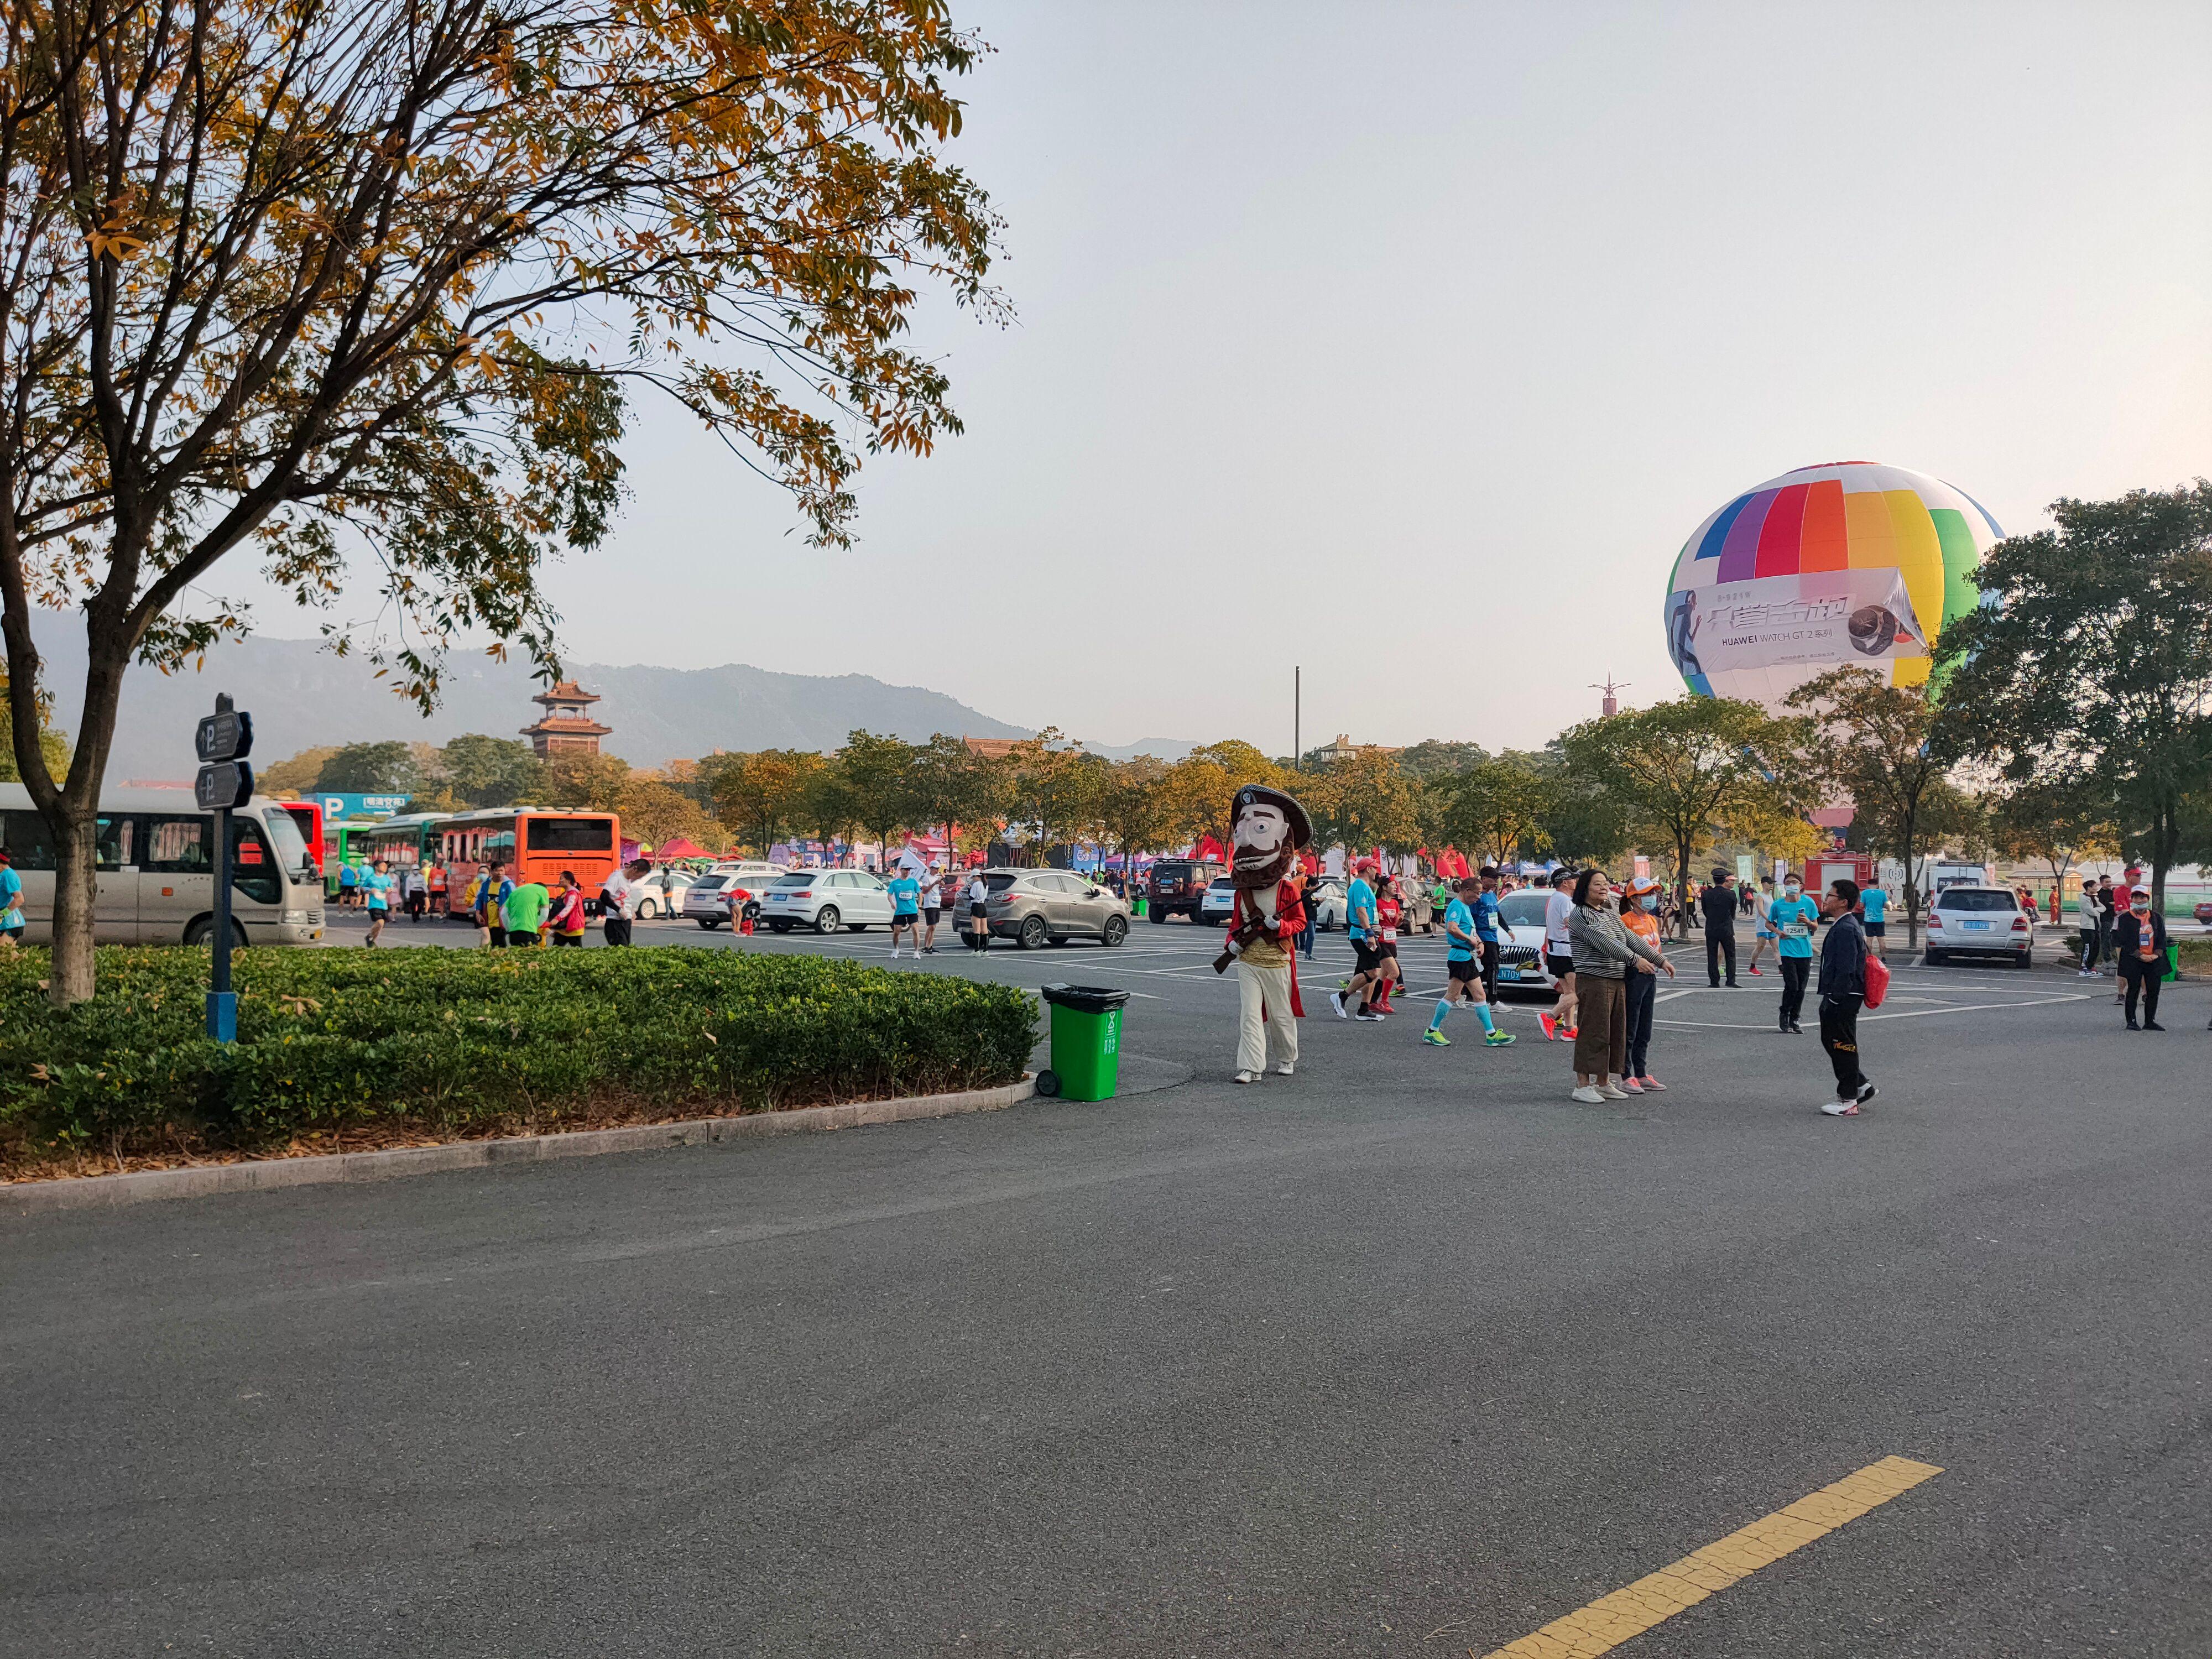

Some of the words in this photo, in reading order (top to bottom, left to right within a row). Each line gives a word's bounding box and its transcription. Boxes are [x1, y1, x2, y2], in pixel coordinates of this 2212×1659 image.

[1722, 635, 1757, 646] HUAWEI
[1760, 632, 1790, 642] WATCH
[1792, 630, 1804, 640] GT
[1814, 628, 1833, 638] 系列
[206, 724, 215, 753] P
[206, 774, 214, 801] P
[325, 798, 343, 820] P
